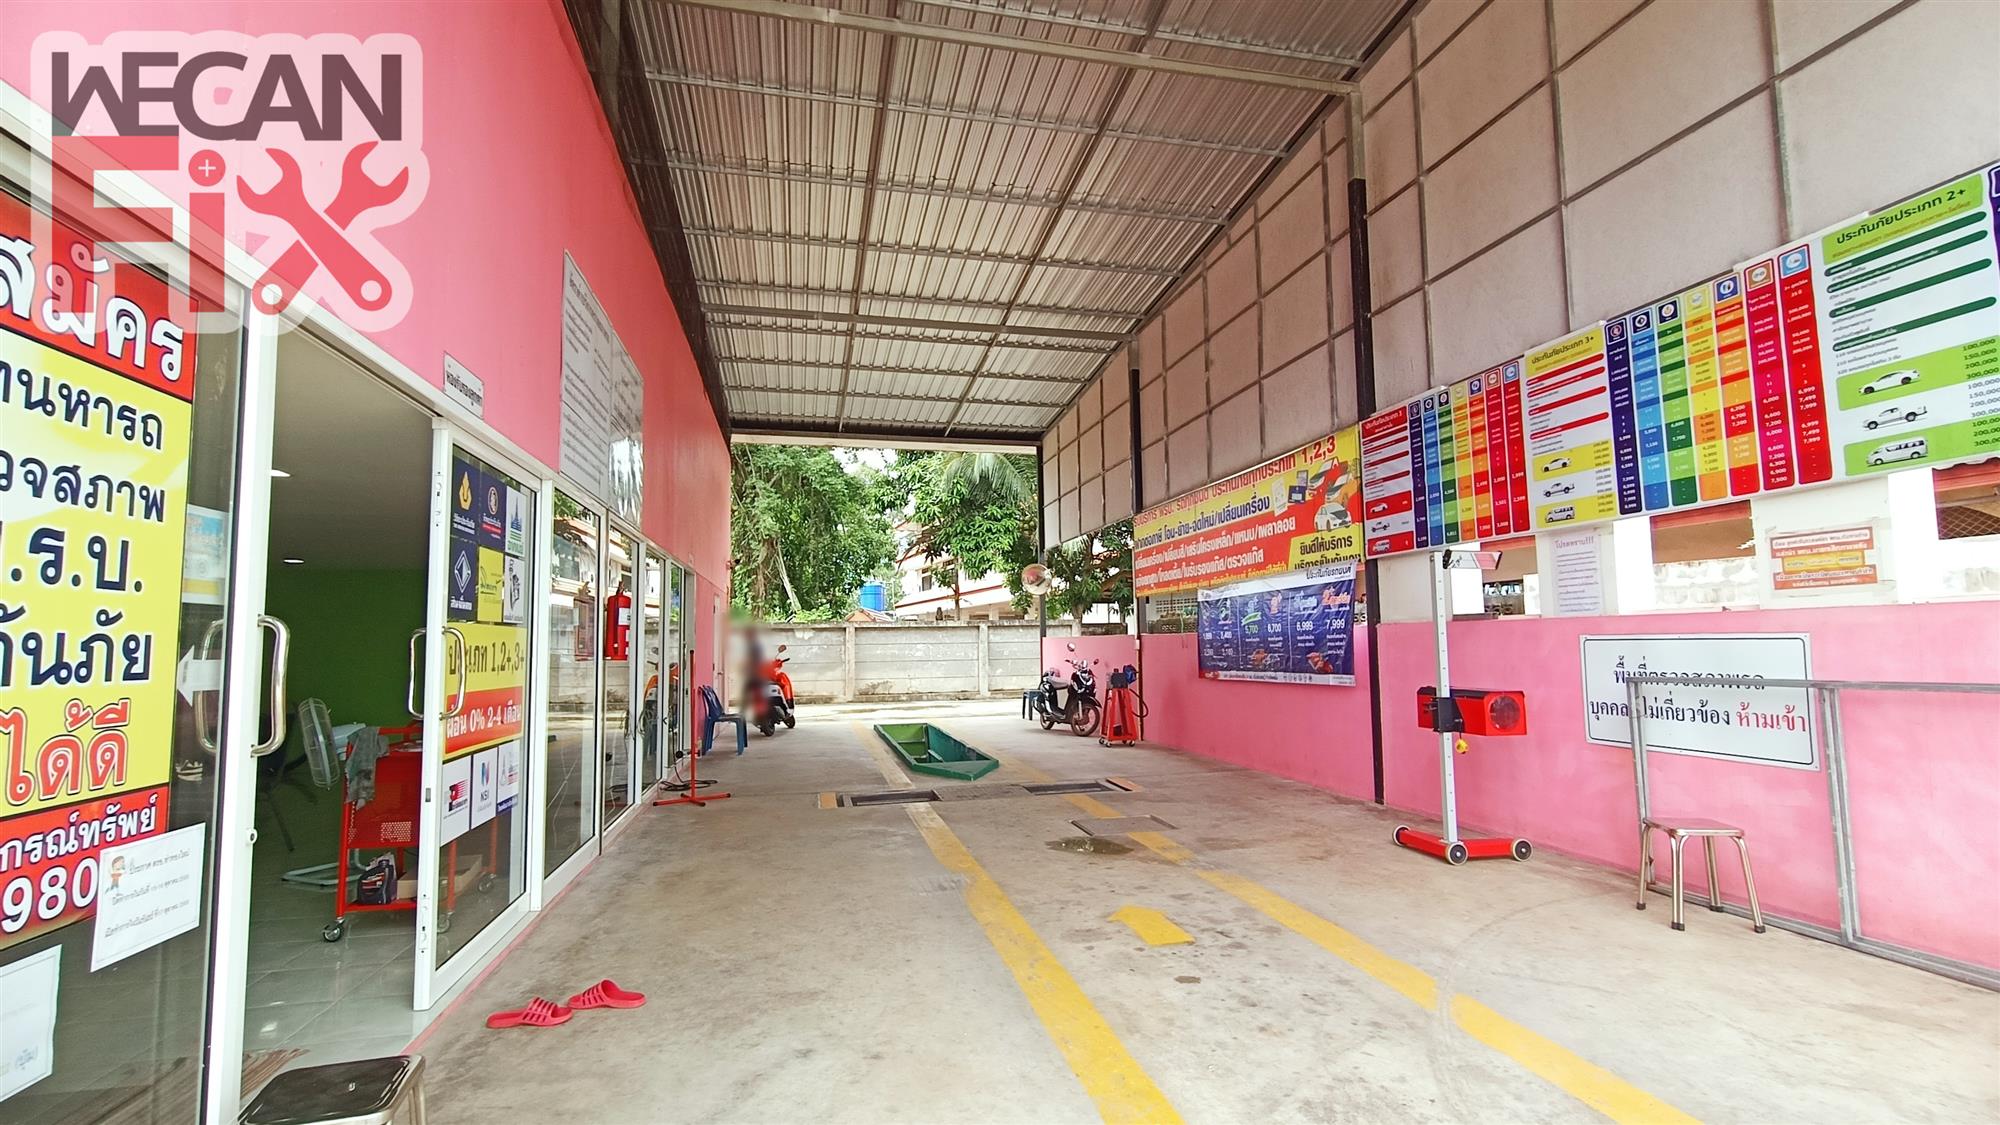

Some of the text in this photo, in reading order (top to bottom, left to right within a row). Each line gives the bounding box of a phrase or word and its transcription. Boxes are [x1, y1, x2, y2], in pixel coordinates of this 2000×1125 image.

[1836, 188, 1966, 244] ประกันภัยประเภท 2+
[1963, 339, 1996, 351] 100,000
[1964, 348, 1997, 360] 150,000
[1177, 489, 1209, 511] รถทุกชนด
[1736, 701, 1807, 732] ห้ามเข้า
[1, 857, 99, 936] 980
